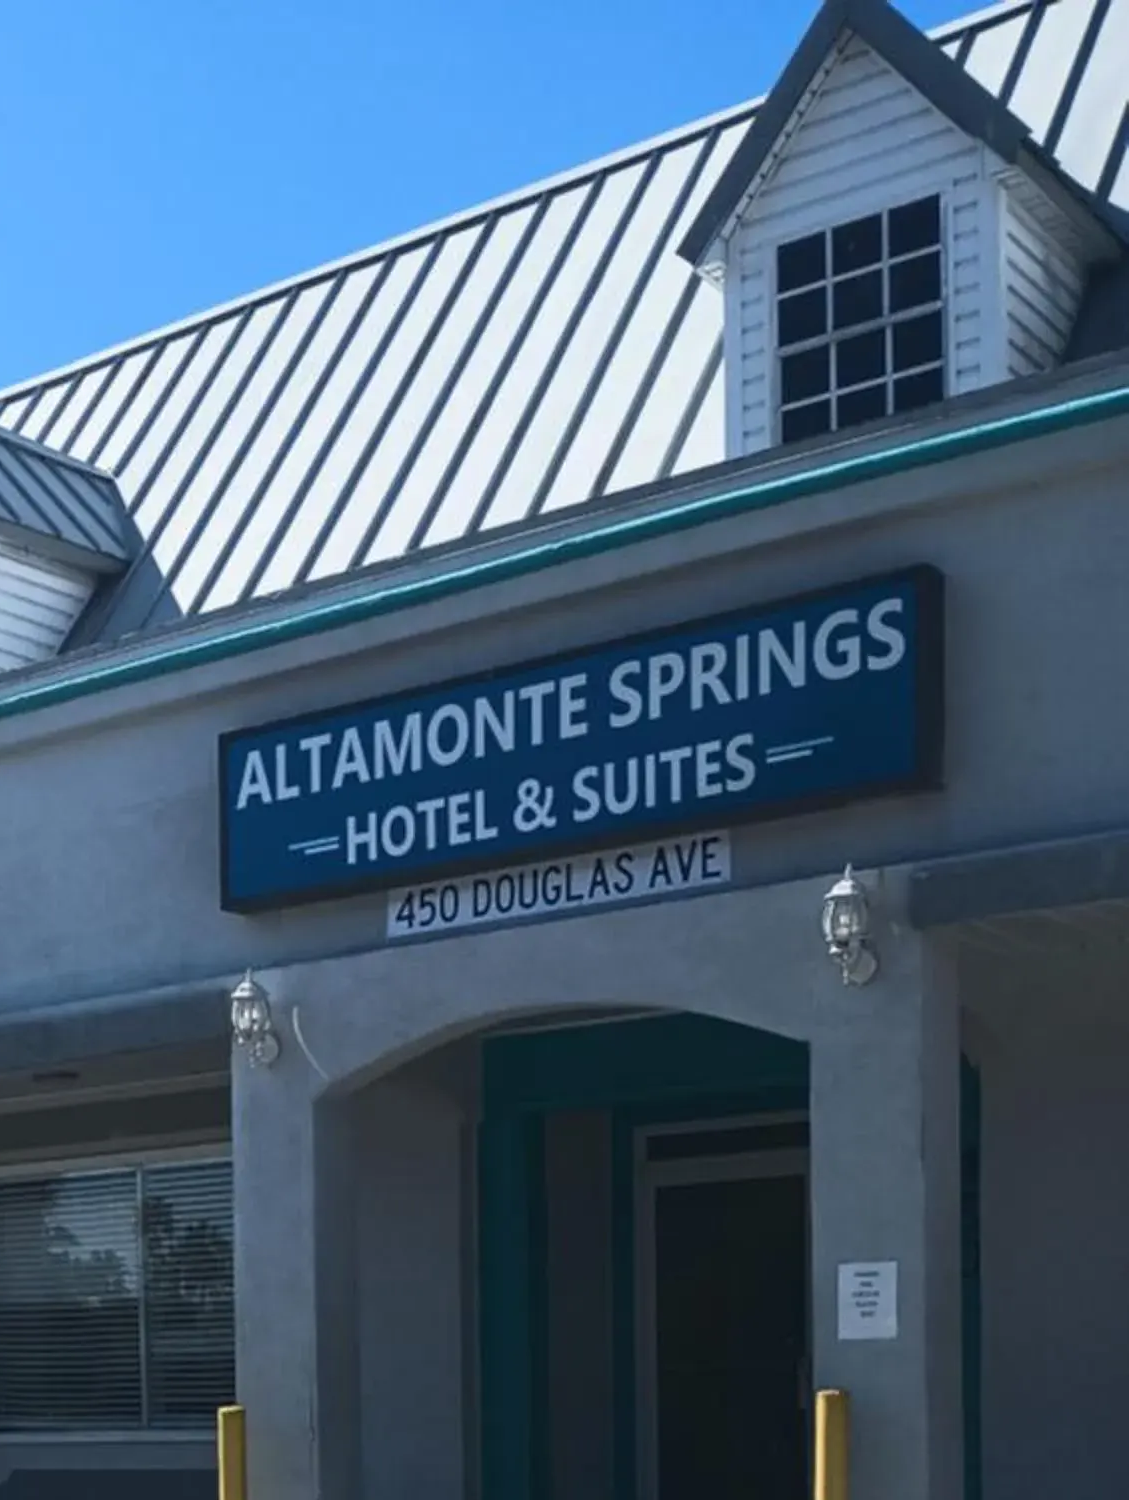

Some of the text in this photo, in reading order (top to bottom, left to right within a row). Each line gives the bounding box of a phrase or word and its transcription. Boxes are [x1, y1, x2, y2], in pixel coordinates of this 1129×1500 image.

[237, 599, 905, 809] ALTAMONTE SPRINGS
[347, 733, 755, 864] HOTEL & SUITES
[395, 837, 721, 929] 450 DOUGLAS AVE
